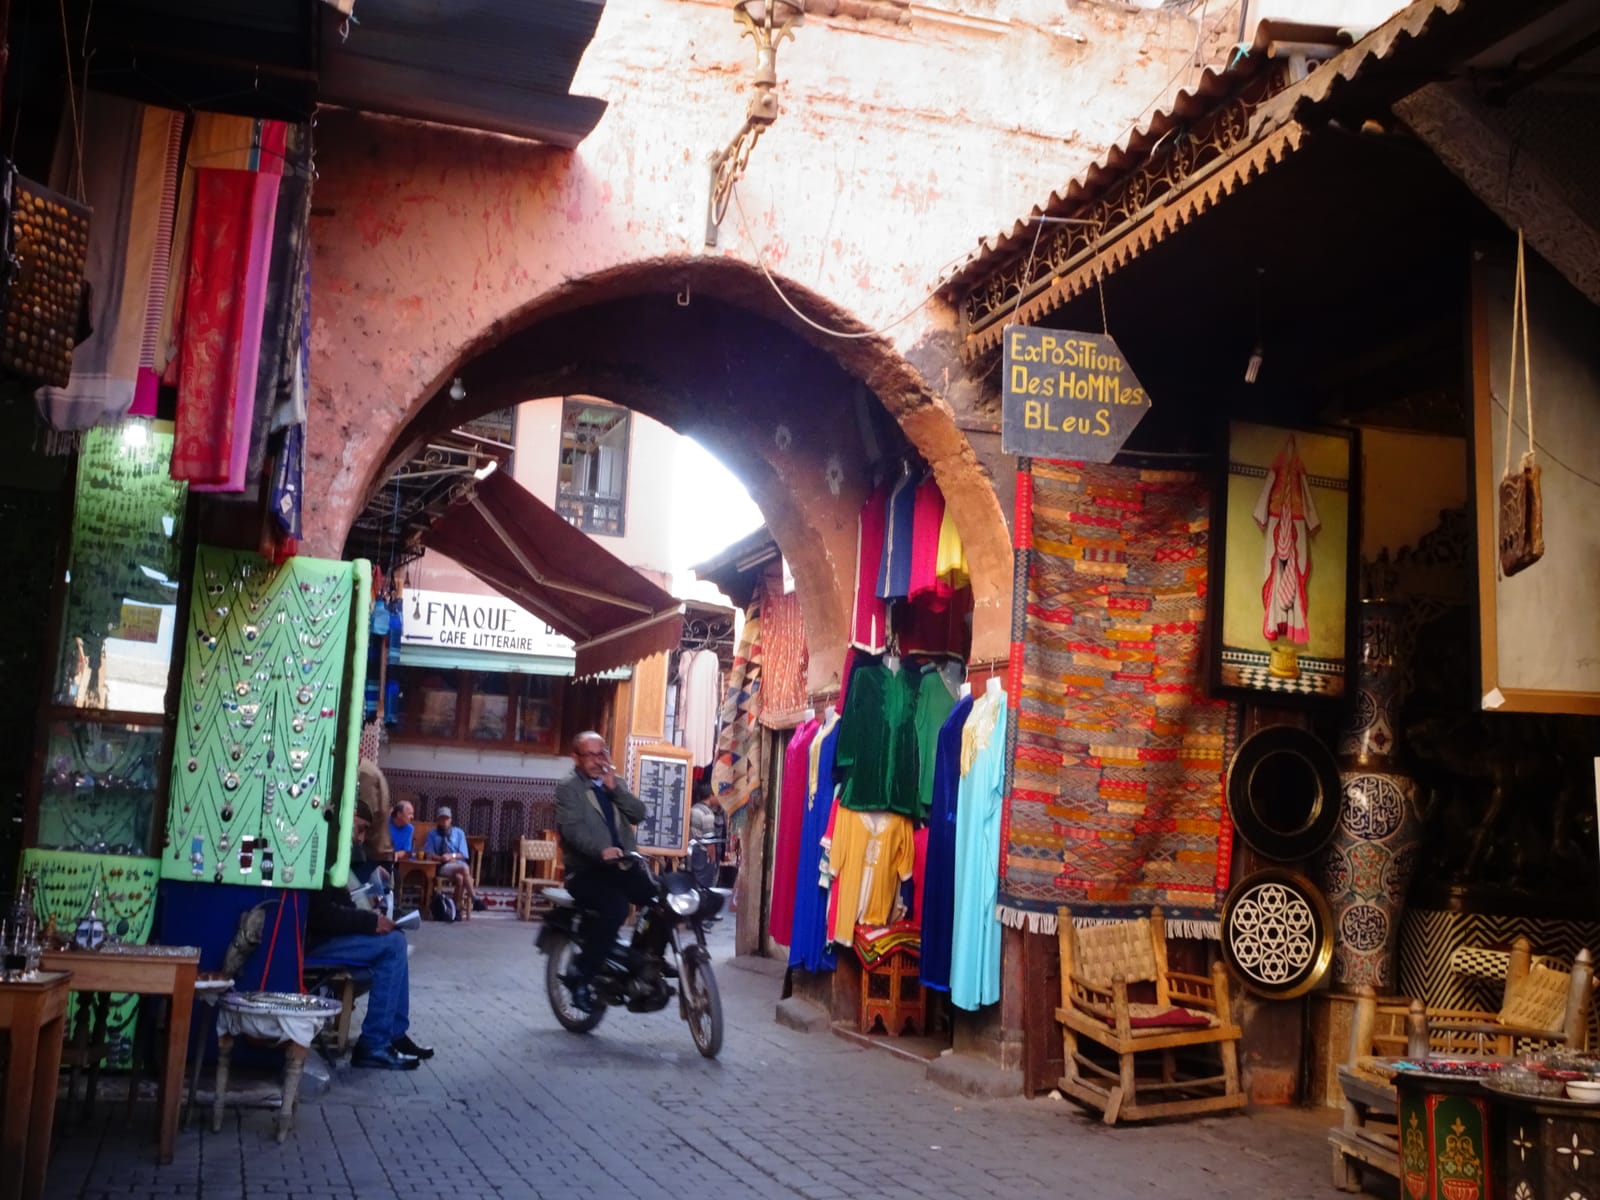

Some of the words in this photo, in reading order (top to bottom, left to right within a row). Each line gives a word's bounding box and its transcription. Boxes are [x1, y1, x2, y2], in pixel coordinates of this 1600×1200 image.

[1011, 365, 1055, 396] Des
[426, 602, 517, 633] FNAQUE
[439, 630, 466, 646] CAFE
[473, 633, 533, 651] LITTERAIRE
